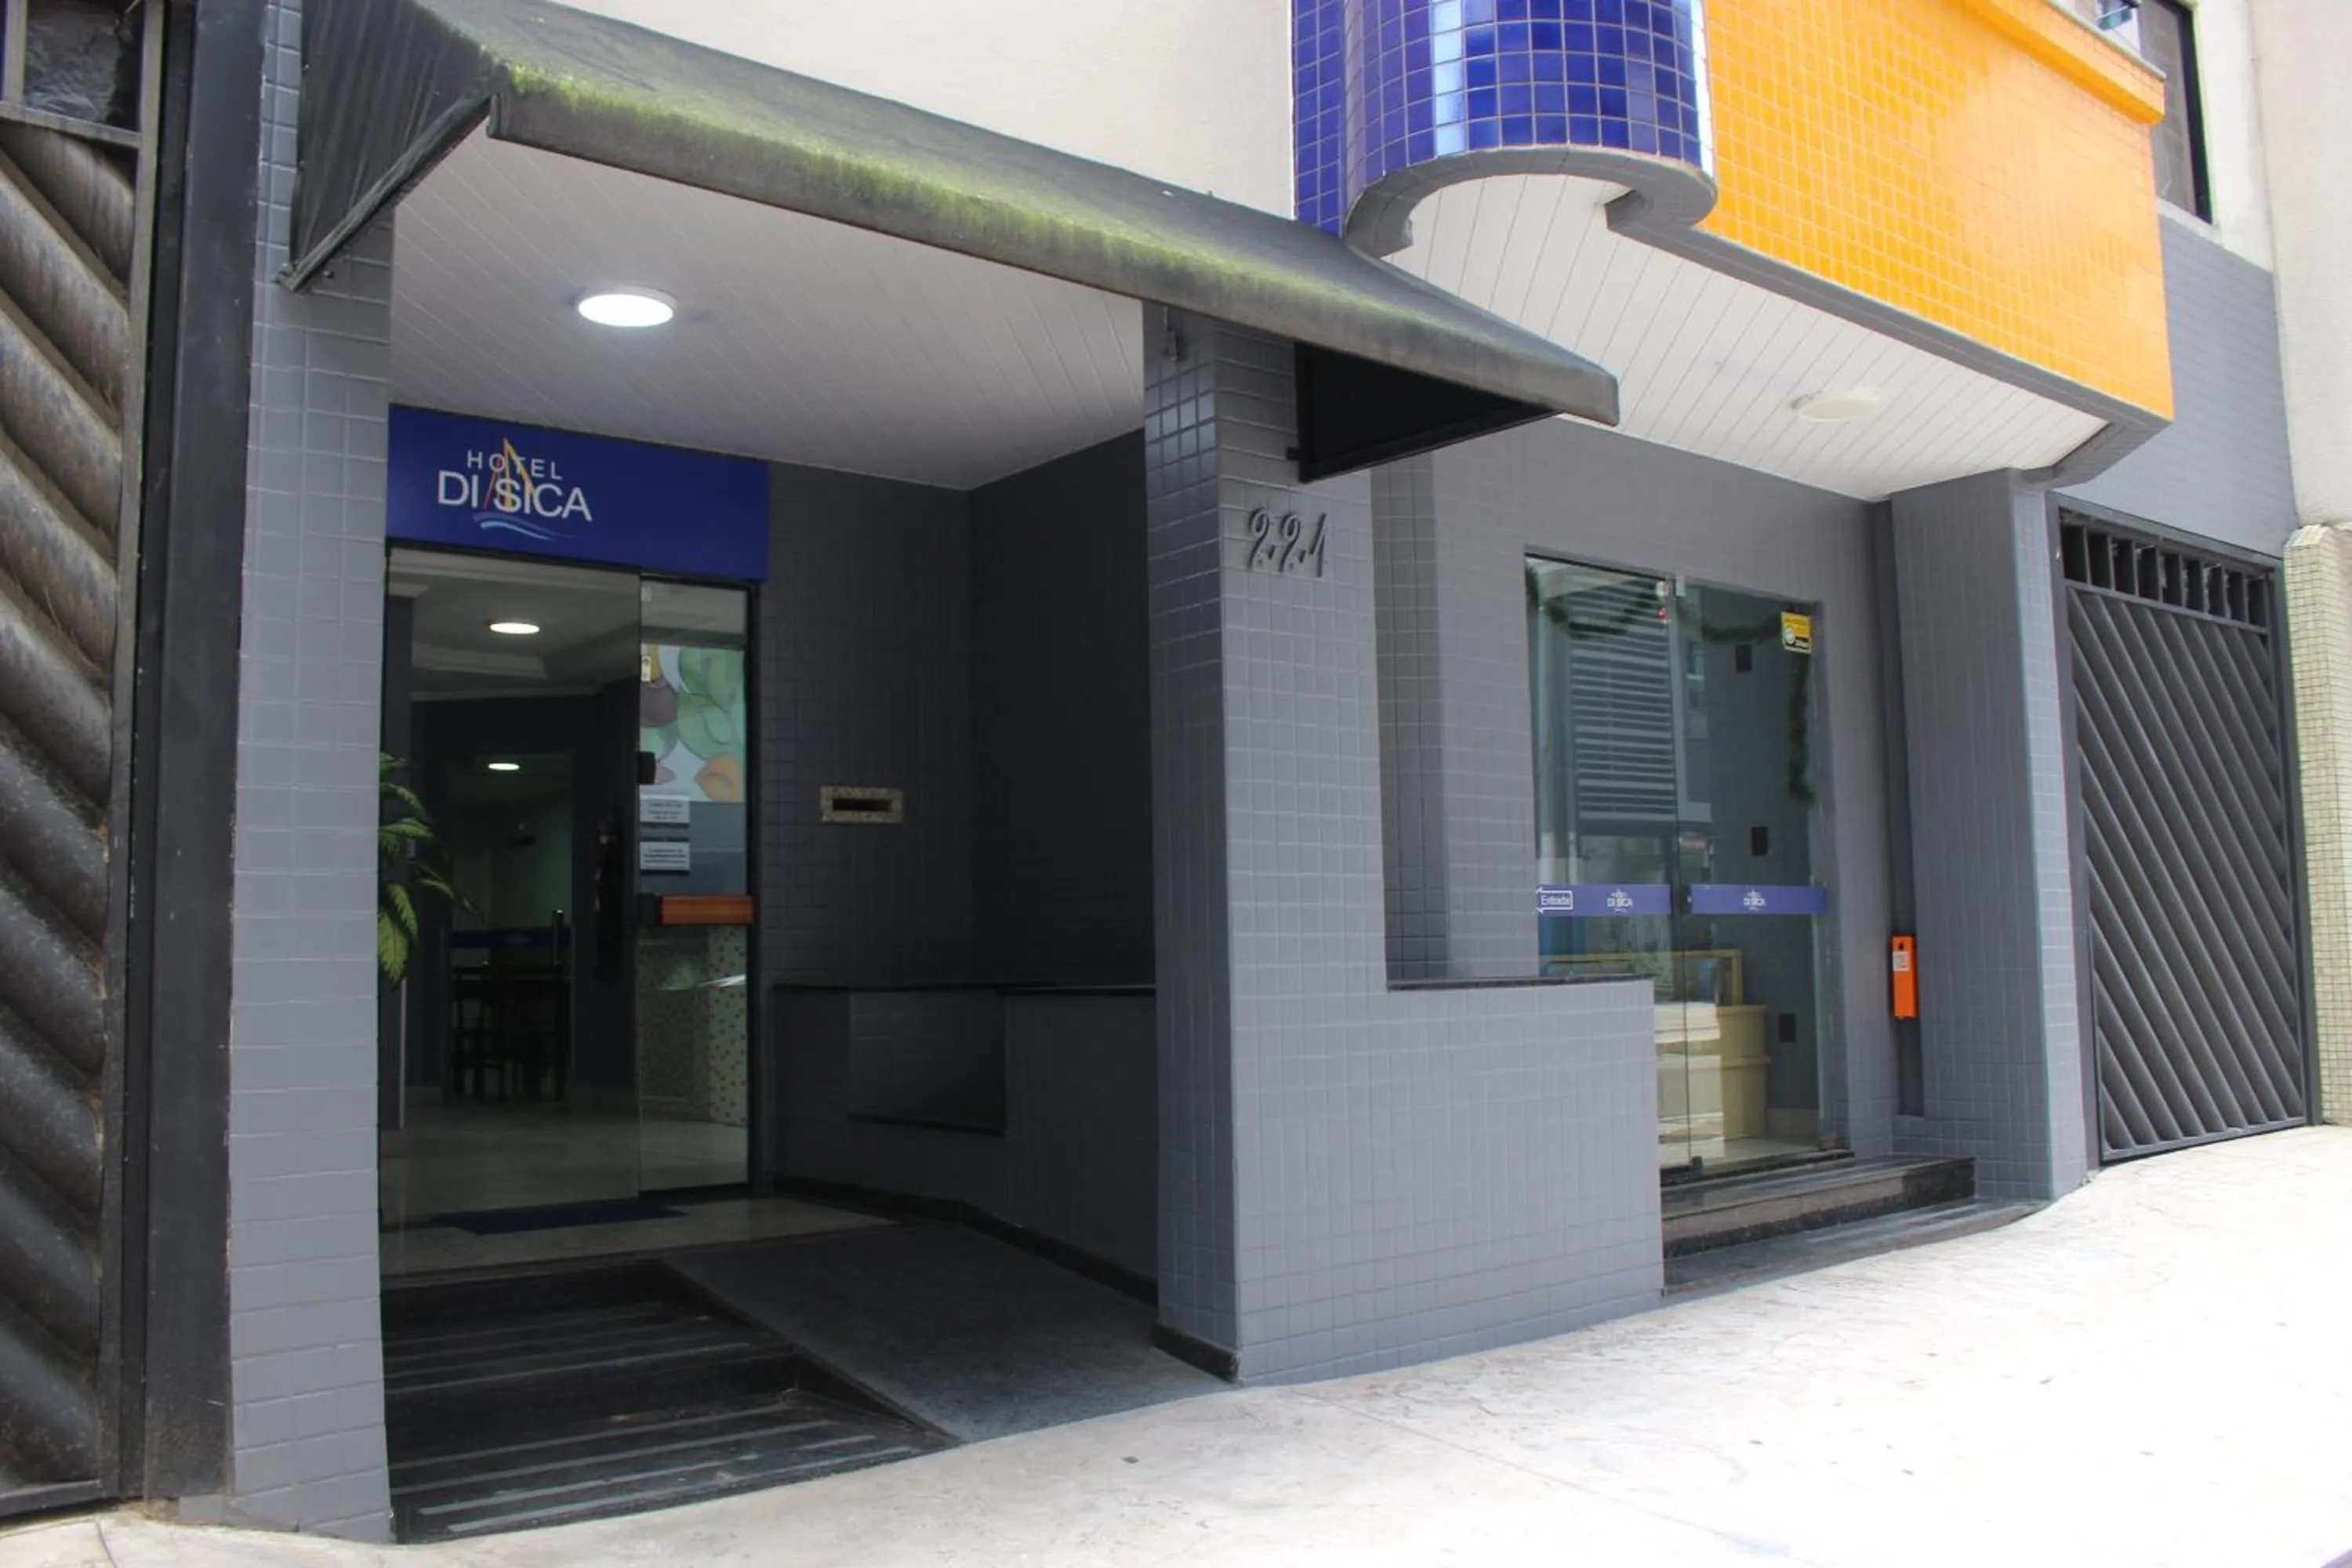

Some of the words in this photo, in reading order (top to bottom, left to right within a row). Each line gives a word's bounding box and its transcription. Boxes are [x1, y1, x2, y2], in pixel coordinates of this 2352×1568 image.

[466, 449, 563, 481] HOTEL
[438, 470, 480, 509] DI
[493, 477, 593, 522] SICA
